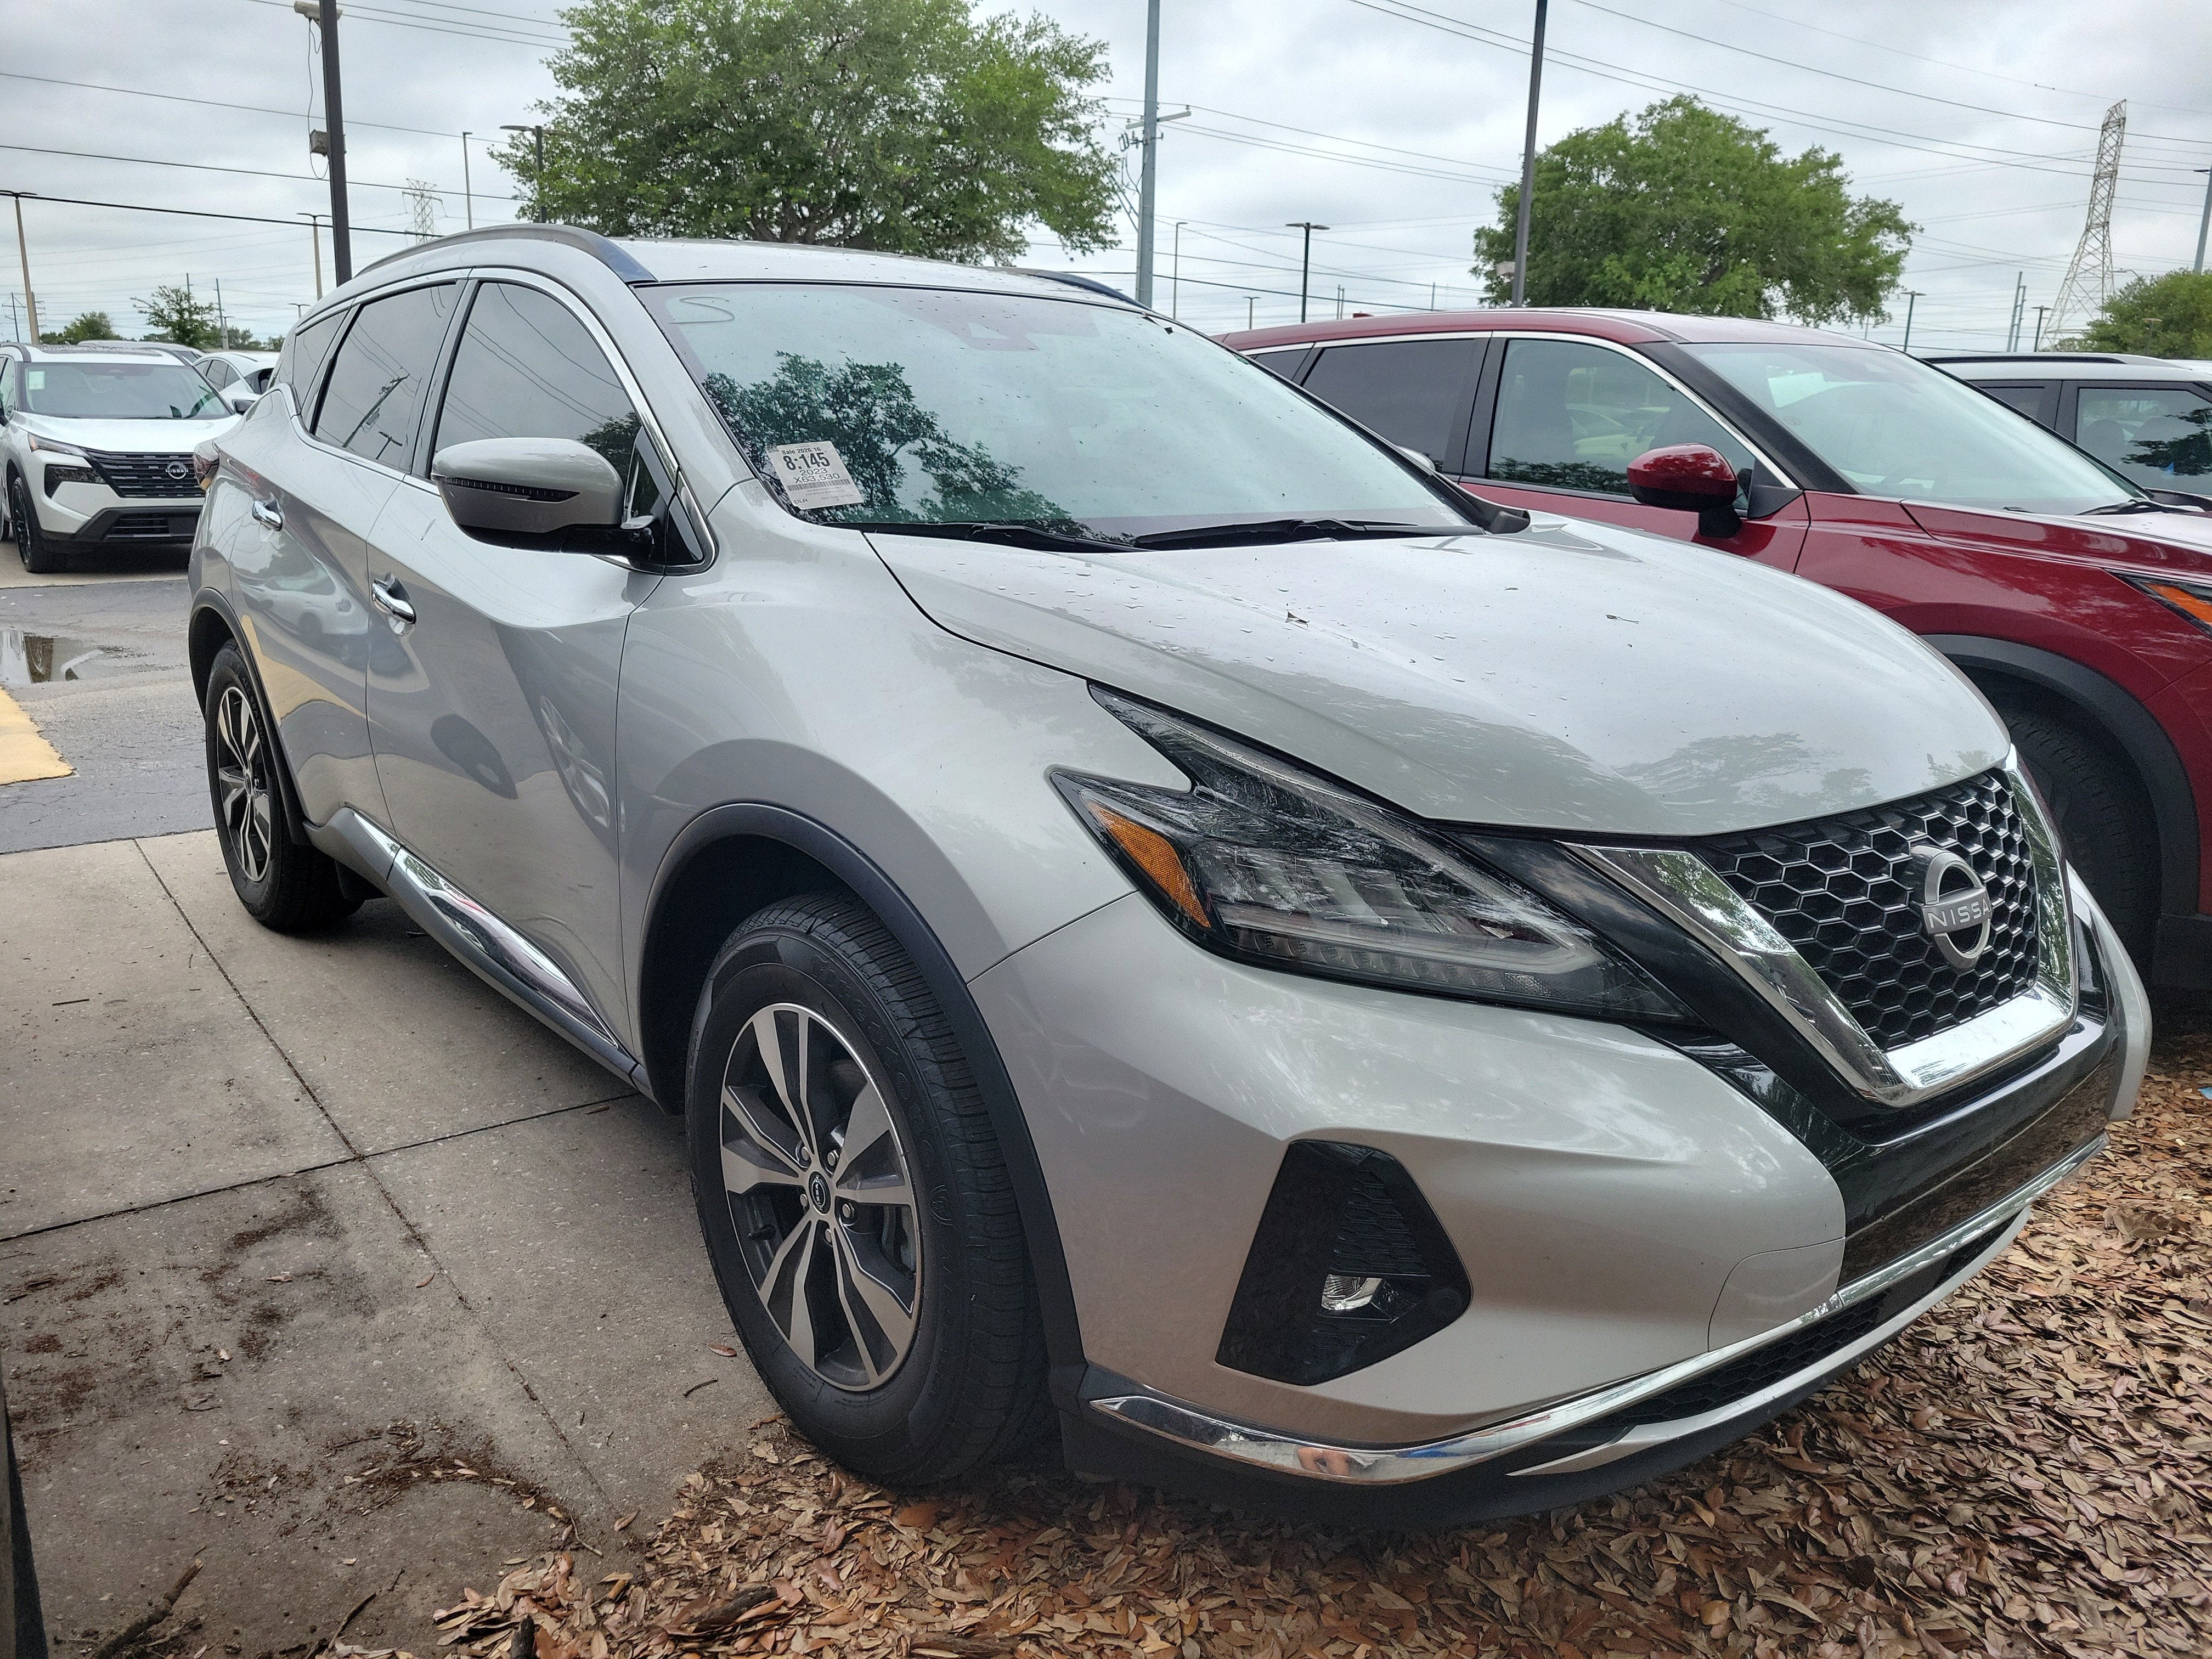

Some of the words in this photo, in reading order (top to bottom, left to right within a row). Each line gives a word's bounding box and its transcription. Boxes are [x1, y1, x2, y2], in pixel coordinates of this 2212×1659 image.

[783, 453, 830, 470] 8:145
[793, 473, 839, 483] X63,530
[1927, 898, 1991, 928] NISSA
